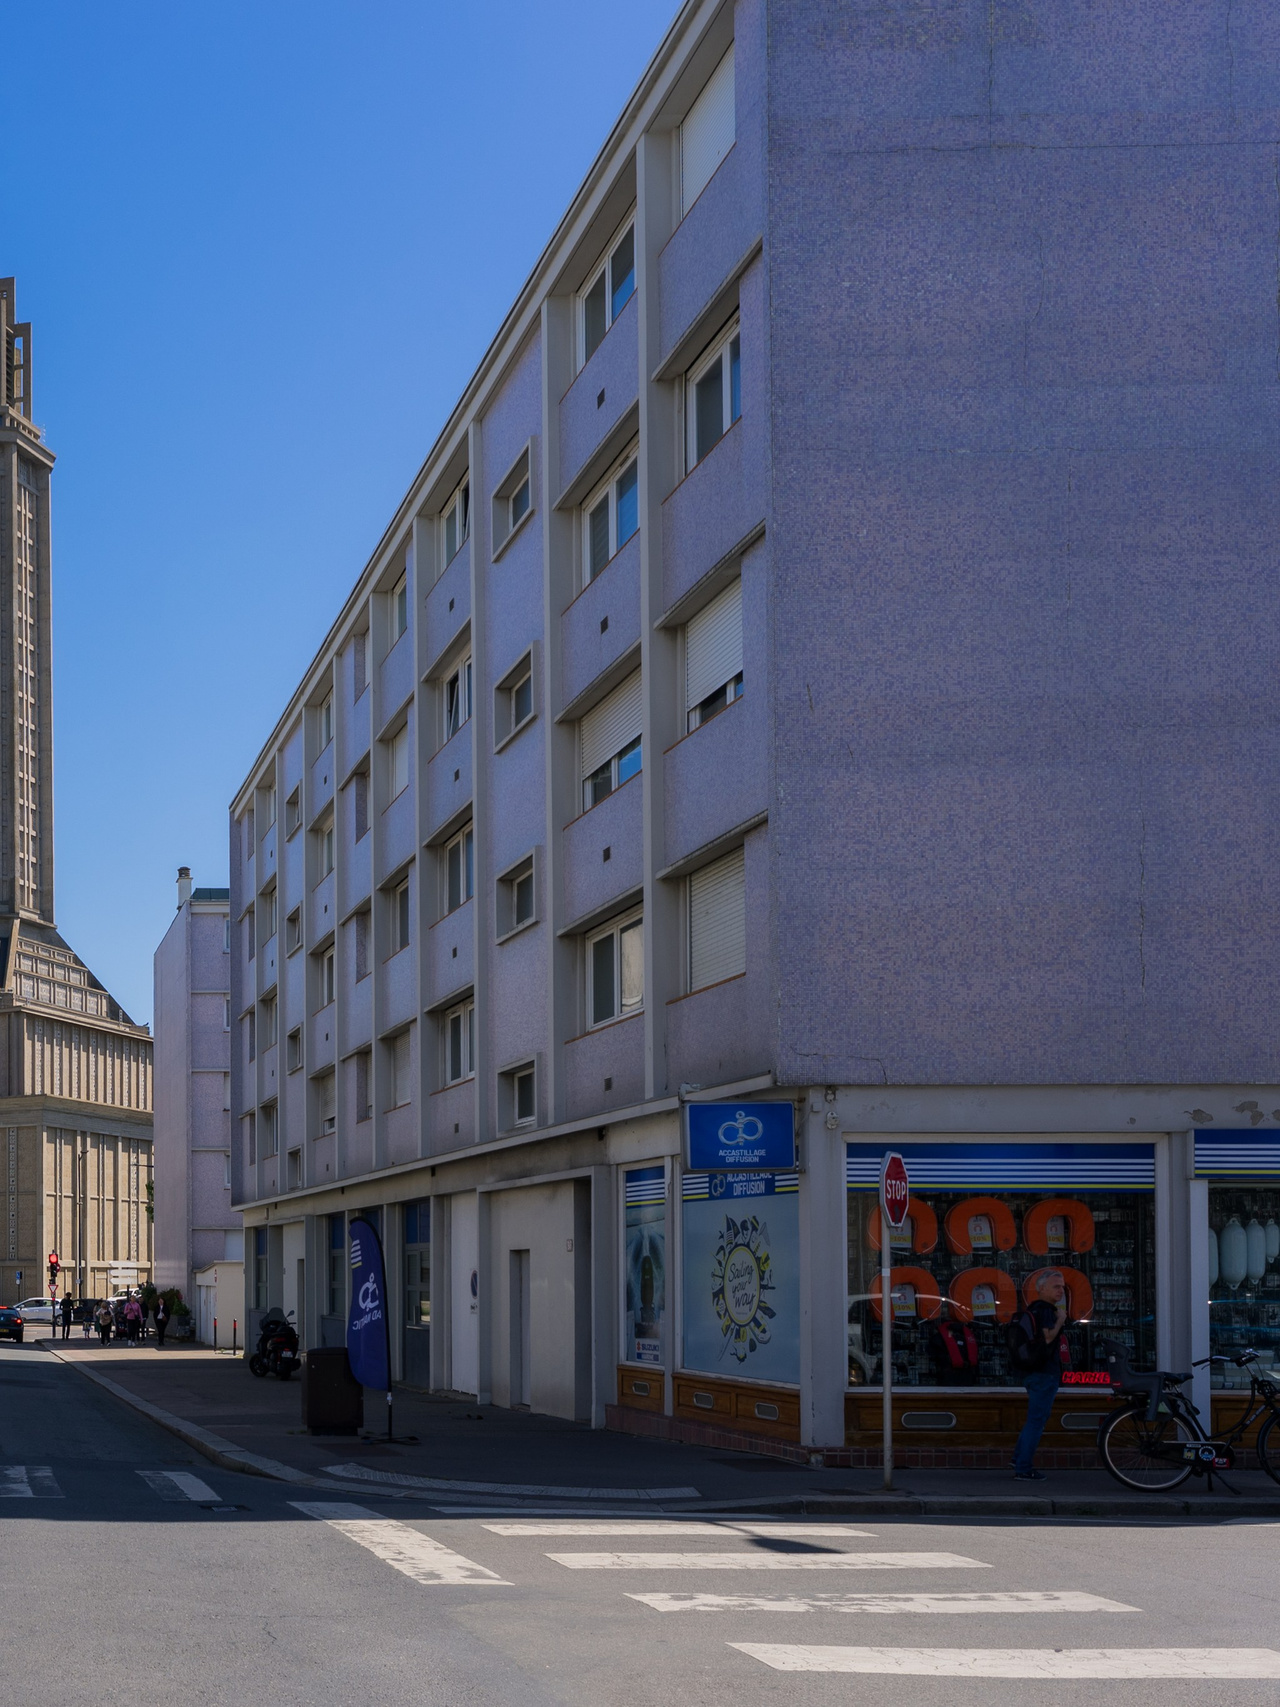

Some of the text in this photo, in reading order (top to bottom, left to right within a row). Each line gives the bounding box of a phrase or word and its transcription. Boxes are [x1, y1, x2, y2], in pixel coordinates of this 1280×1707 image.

[718, 1149, 766, 1157] ACCASTILLAGE
[733, 1180, 765, 1196] DIFFUSION
[886, 1179, 907, 1201] STOP
[728, 1260, 755, 1284] Sailing
[732, 1281, 748, 1299] your
[734, 1292, 756, 1312] way
